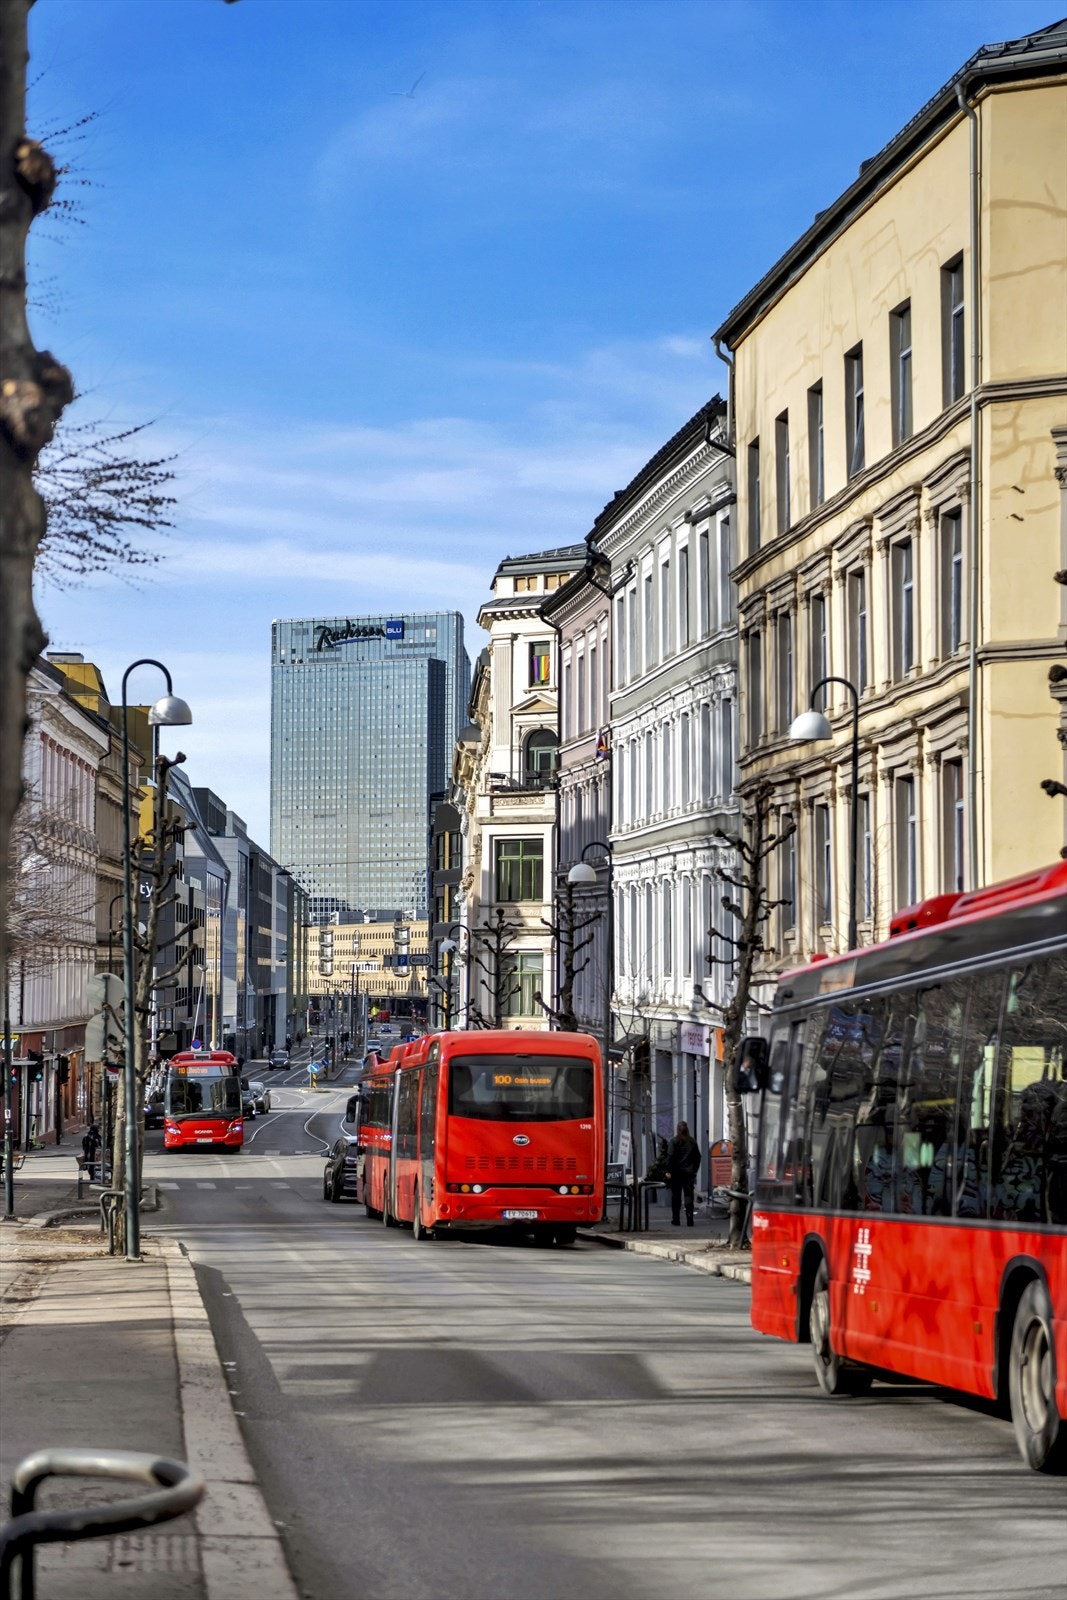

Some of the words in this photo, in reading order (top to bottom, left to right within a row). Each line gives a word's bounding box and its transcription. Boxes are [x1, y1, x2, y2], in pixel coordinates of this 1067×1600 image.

[315, 620, 386, 651] Radisson
[411, 956, 424, 964] Ring
[494, 1075, 512, 1084] 100
